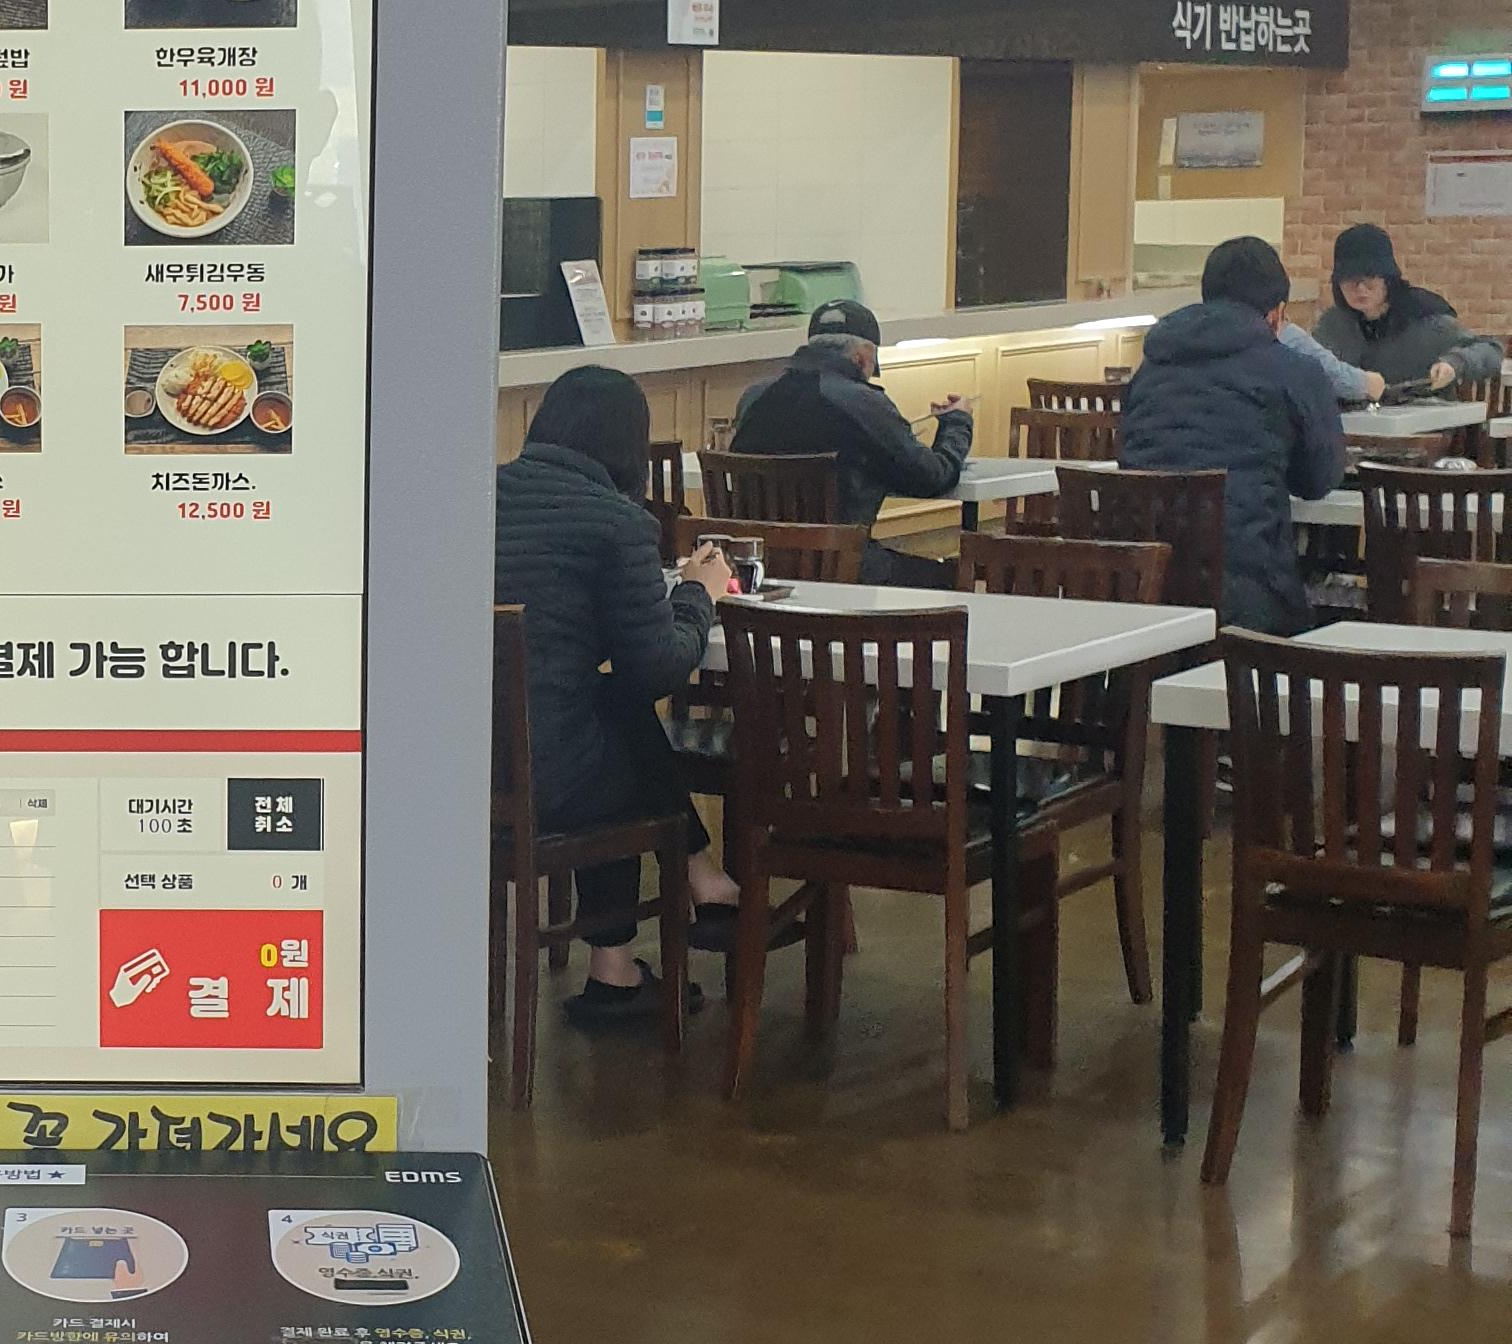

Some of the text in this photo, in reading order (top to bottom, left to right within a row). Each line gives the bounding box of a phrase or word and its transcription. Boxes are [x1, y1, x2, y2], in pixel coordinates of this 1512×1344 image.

[1171, 0, 1313, 56] 식기 반납하는곳
[154, 45, 258, 70] 한우육개장
[7, 78, 29, 100] 원
[178, 76, 275, 99] 11,000 원
[144, 262, 266, 285] 새우튀김우동
[177, 291, 262, 314] 7,500 원
[1, 498, 22, 521] 원
[177, 499, 272, 521] 12,500 원
[68, 640, 147, 680] 가능
[159, 638, 291, 680] 합니다.
[128, 798, 194, 815] 대기시간
[138, 817, 194, 834] 100 초
[124, 873, 194, 890] 선택 상품
[272, 873, 308, 891] 0 개
[15, 1212, 28, 1223] 3
[281, 1214, 293, 1224] 4
[52, 1317, 137, 1330] 카드 결제시
